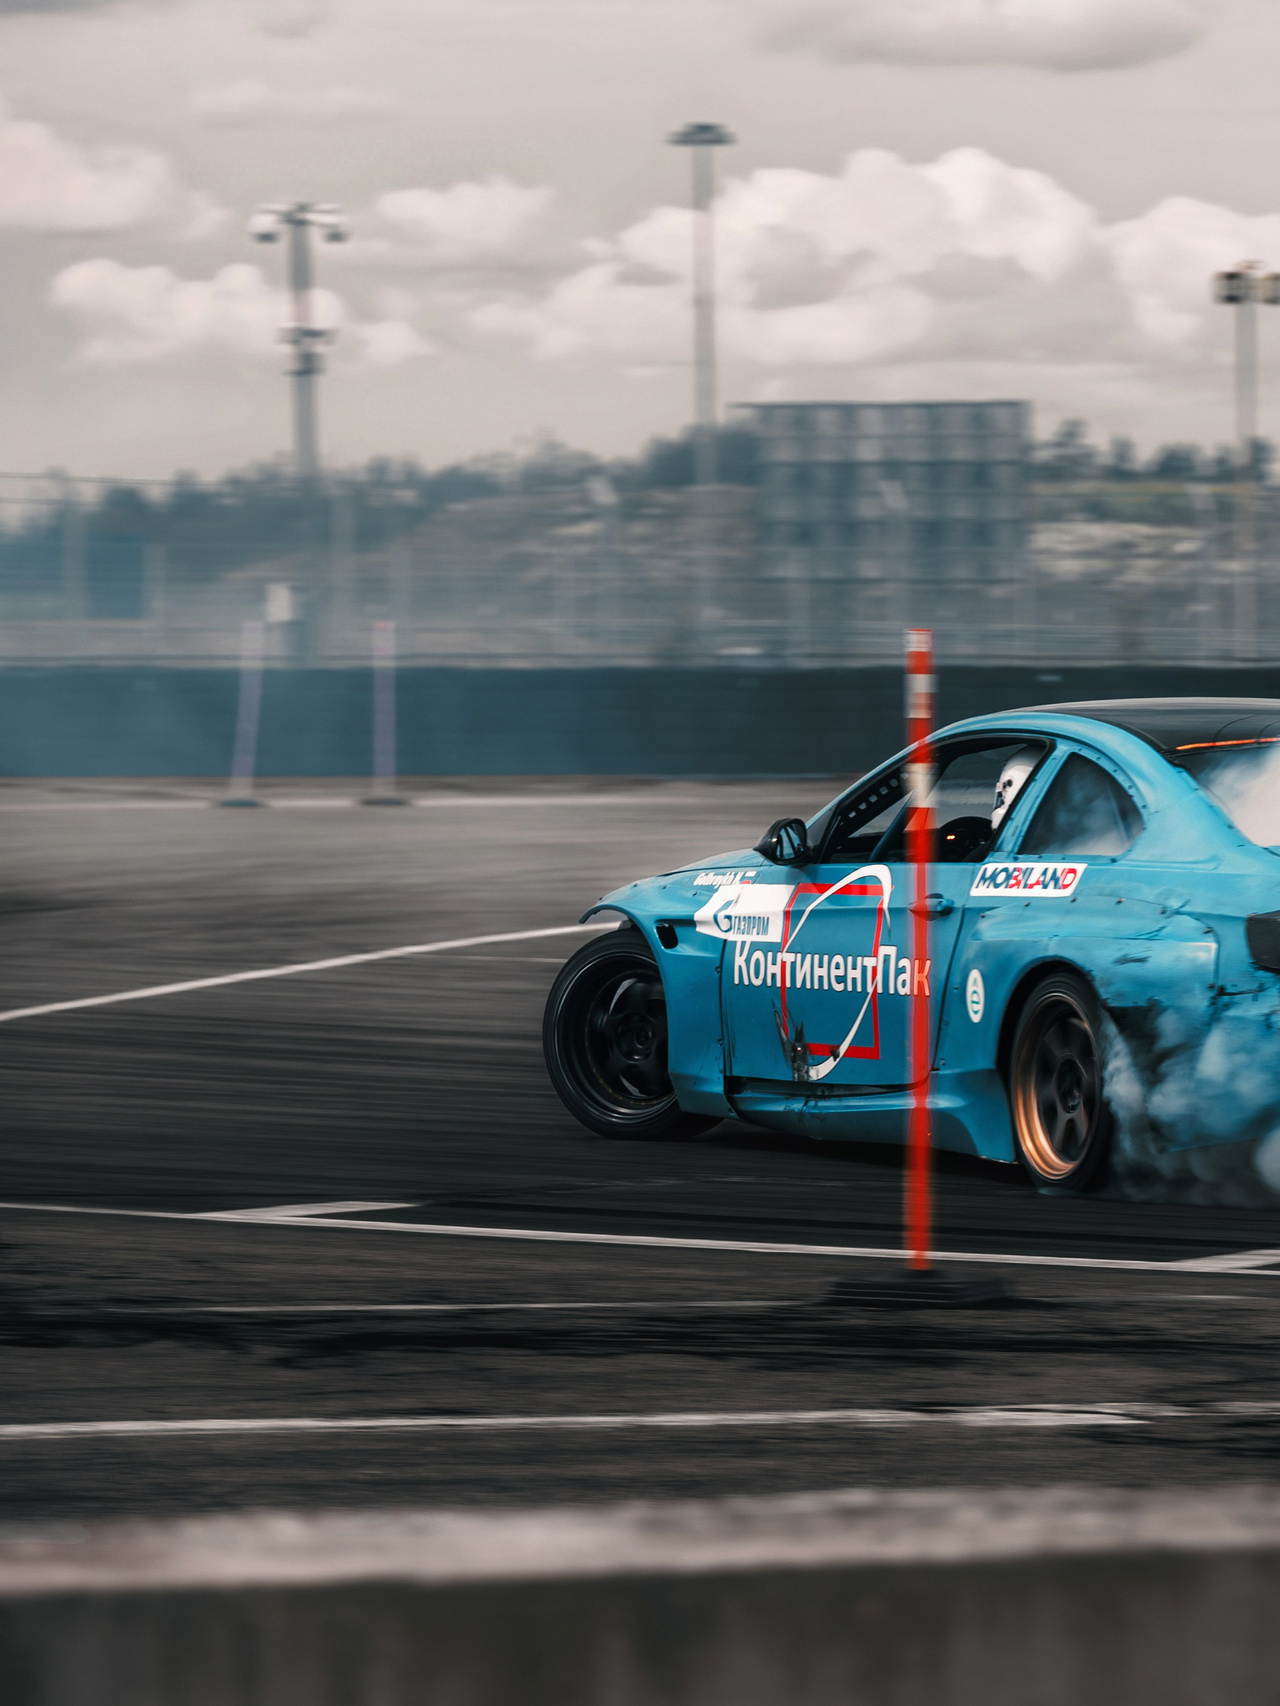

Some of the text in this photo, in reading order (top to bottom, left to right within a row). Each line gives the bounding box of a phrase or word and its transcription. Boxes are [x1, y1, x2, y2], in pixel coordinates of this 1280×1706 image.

[975, 866, 1078, 890] MOBILAND
[732, 915, 770, 936] ГАЗПРОМ
[733, 940, 932, 997] КонтинентПак
